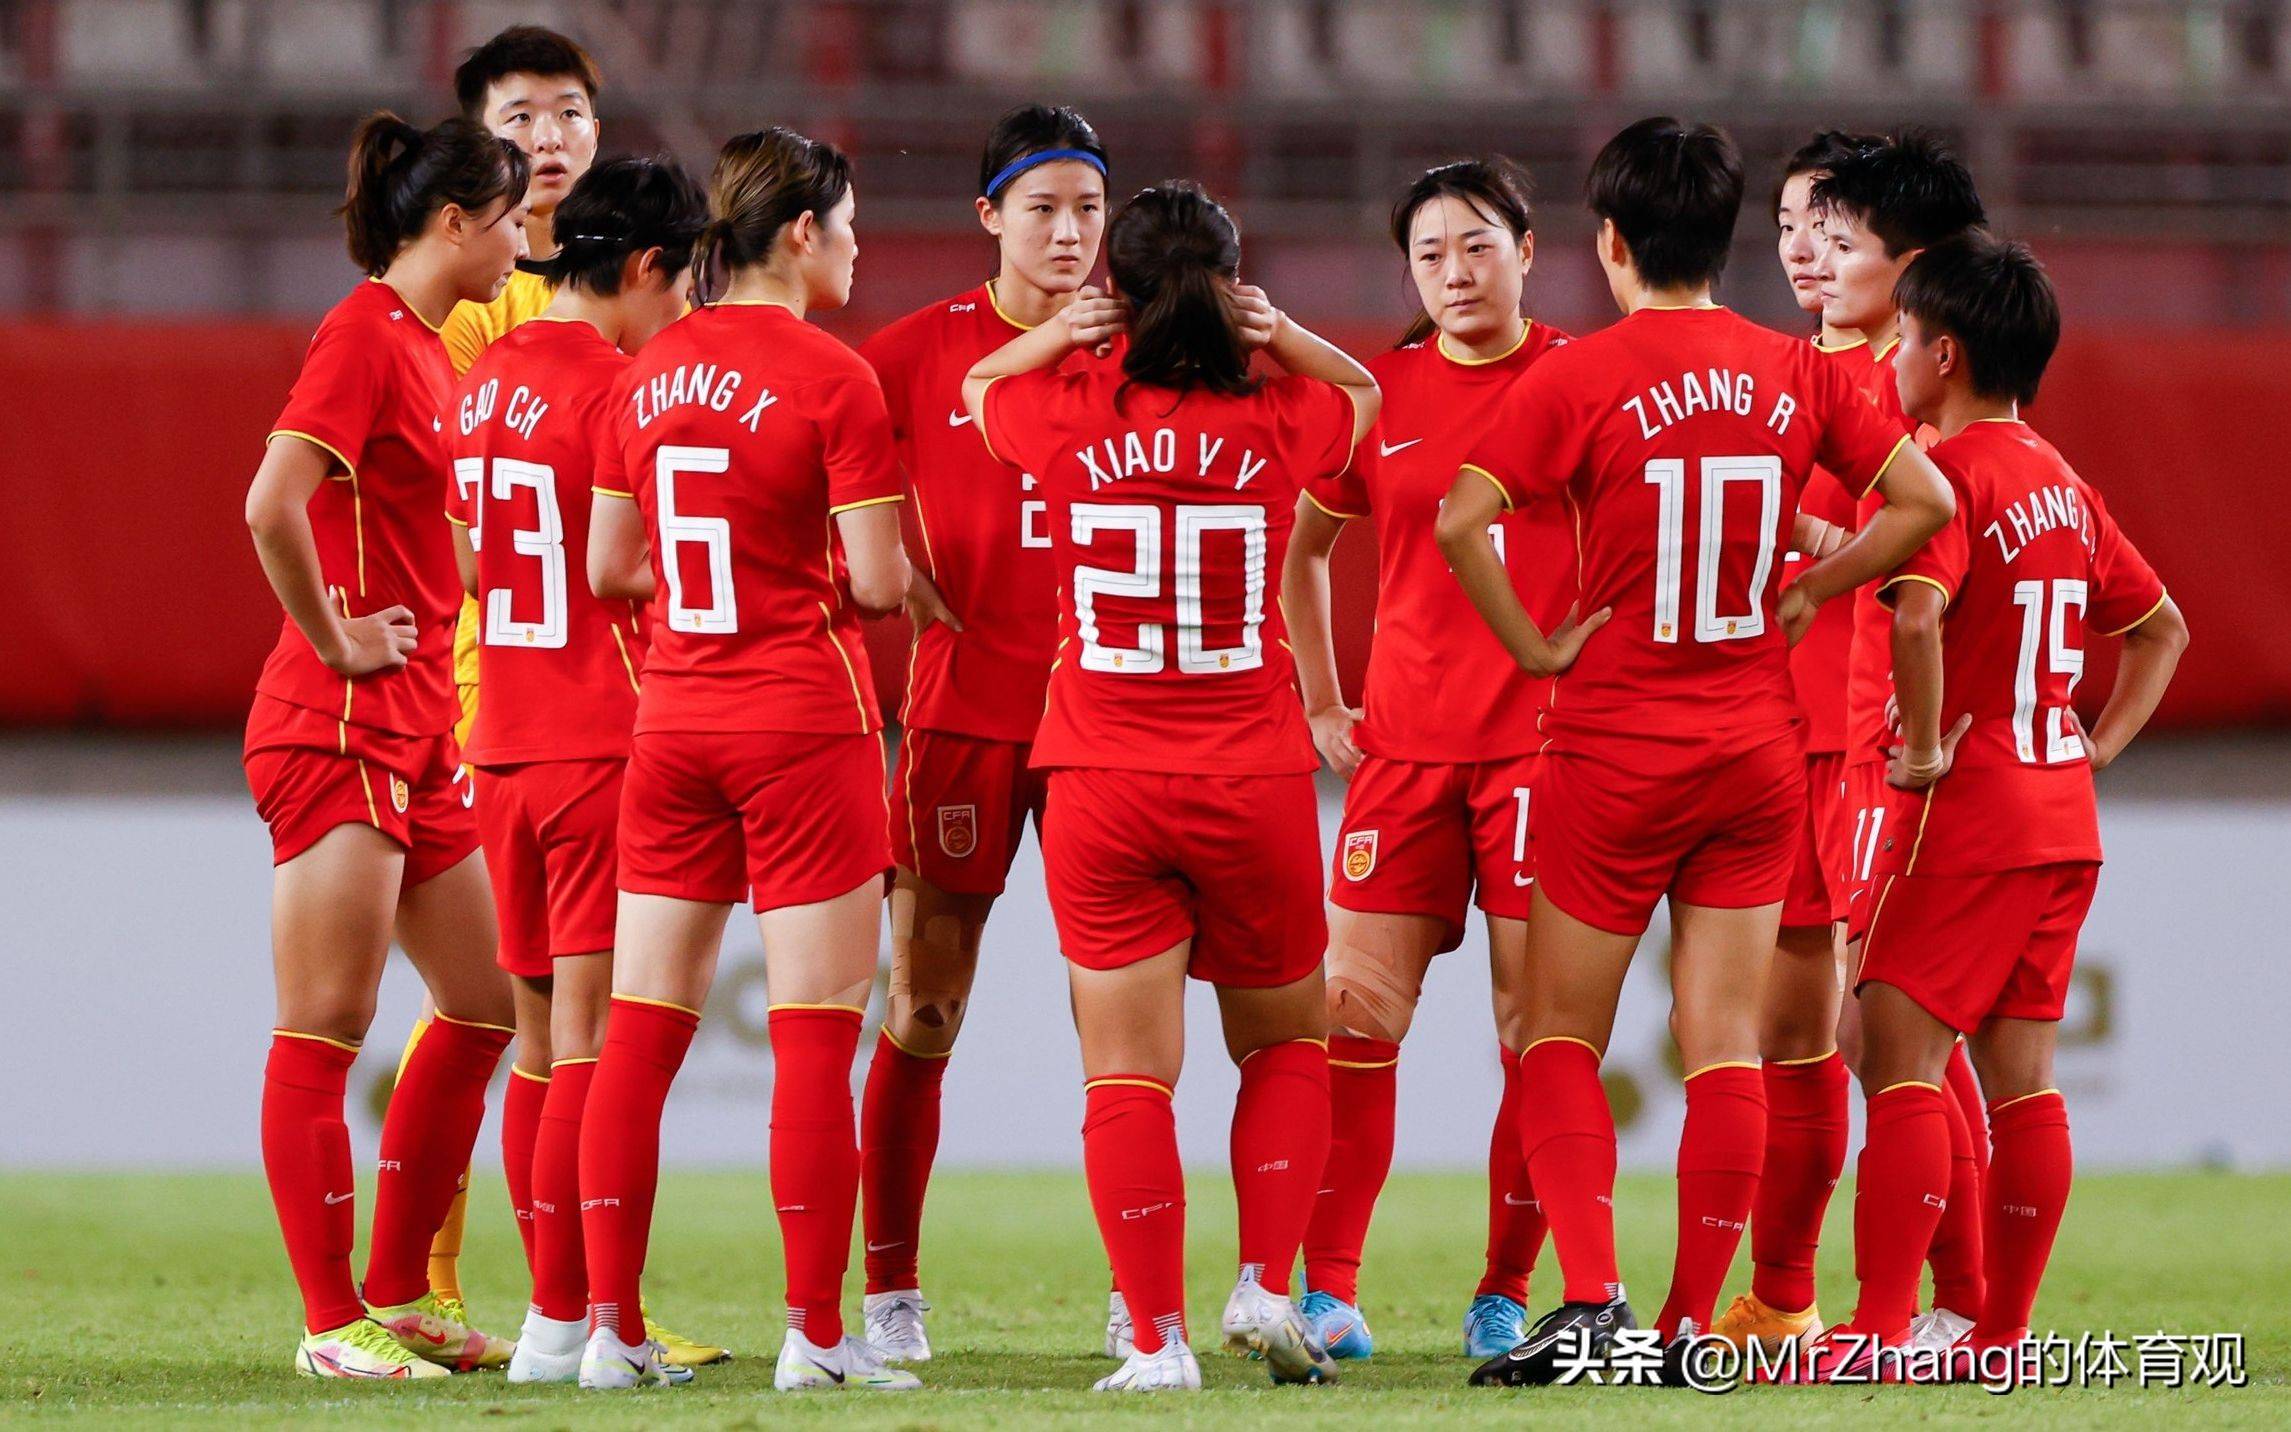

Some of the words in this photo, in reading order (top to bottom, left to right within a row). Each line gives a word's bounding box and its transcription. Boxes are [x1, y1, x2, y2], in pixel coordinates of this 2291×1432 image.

[460, 378, 499, 436] GAO
[505, 386, 549, 440] CH
[632, 363, 742, 430] ZHANG
[738, 388, 778, 433] X
[1622, 368, 1754, 441] ZHANG
[1766, 391, 1796, 436] R
[1075, 428, 1176, 491] XIAO
[1198, 432, 1225, 477] Y
[1234, 449, 1267, 491] Y
[655, 445, 739, 635] 6
[1644, 455, 1782, 644] 10
[1984, 485, 2079, 564] ZHANG
[1070, 504, 1266, 675] 20
[2012, 579, 2088, 763] 15
[943, 810, 970, 820] CFA
[1851, 806, 1886, 882] 11
[1702, 1216, 1744, 1231] CFA
